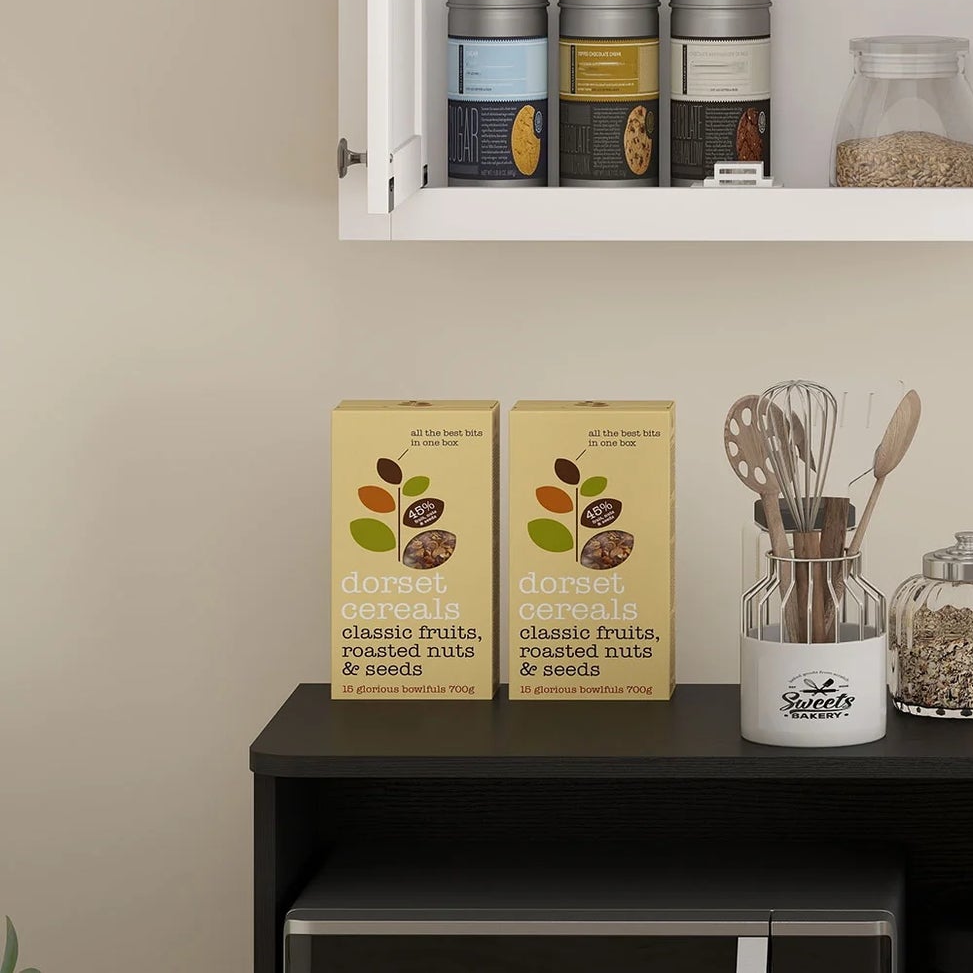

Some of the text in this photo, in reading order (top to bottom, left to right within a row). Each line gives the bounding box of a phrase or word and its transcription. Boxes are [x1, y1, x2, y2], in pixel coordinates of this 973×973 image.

[341, 572, 448, 594] dorset
[519, 572, 625, 594] dorset
[340, 598, 460, 620] cereals
[519, 598, 638, 620] cereals
[342, 625, 482, 642] classic fruits,
[520, 626, 660, 642] classic fruits,
[342, 644, 475, 658] roasted nuts
[520, 644, 652, 658] roasted nuts
[342, 662, 422, 676] & seeds
[520, 662, 600, 676] & seeds
[342, 685, 475, 694] 15 glorious bowlfuls 700g
[520, 686, 652, 695] 15 glorious bowlfuls 700g
[780, 692, 855, 712] Sweets
